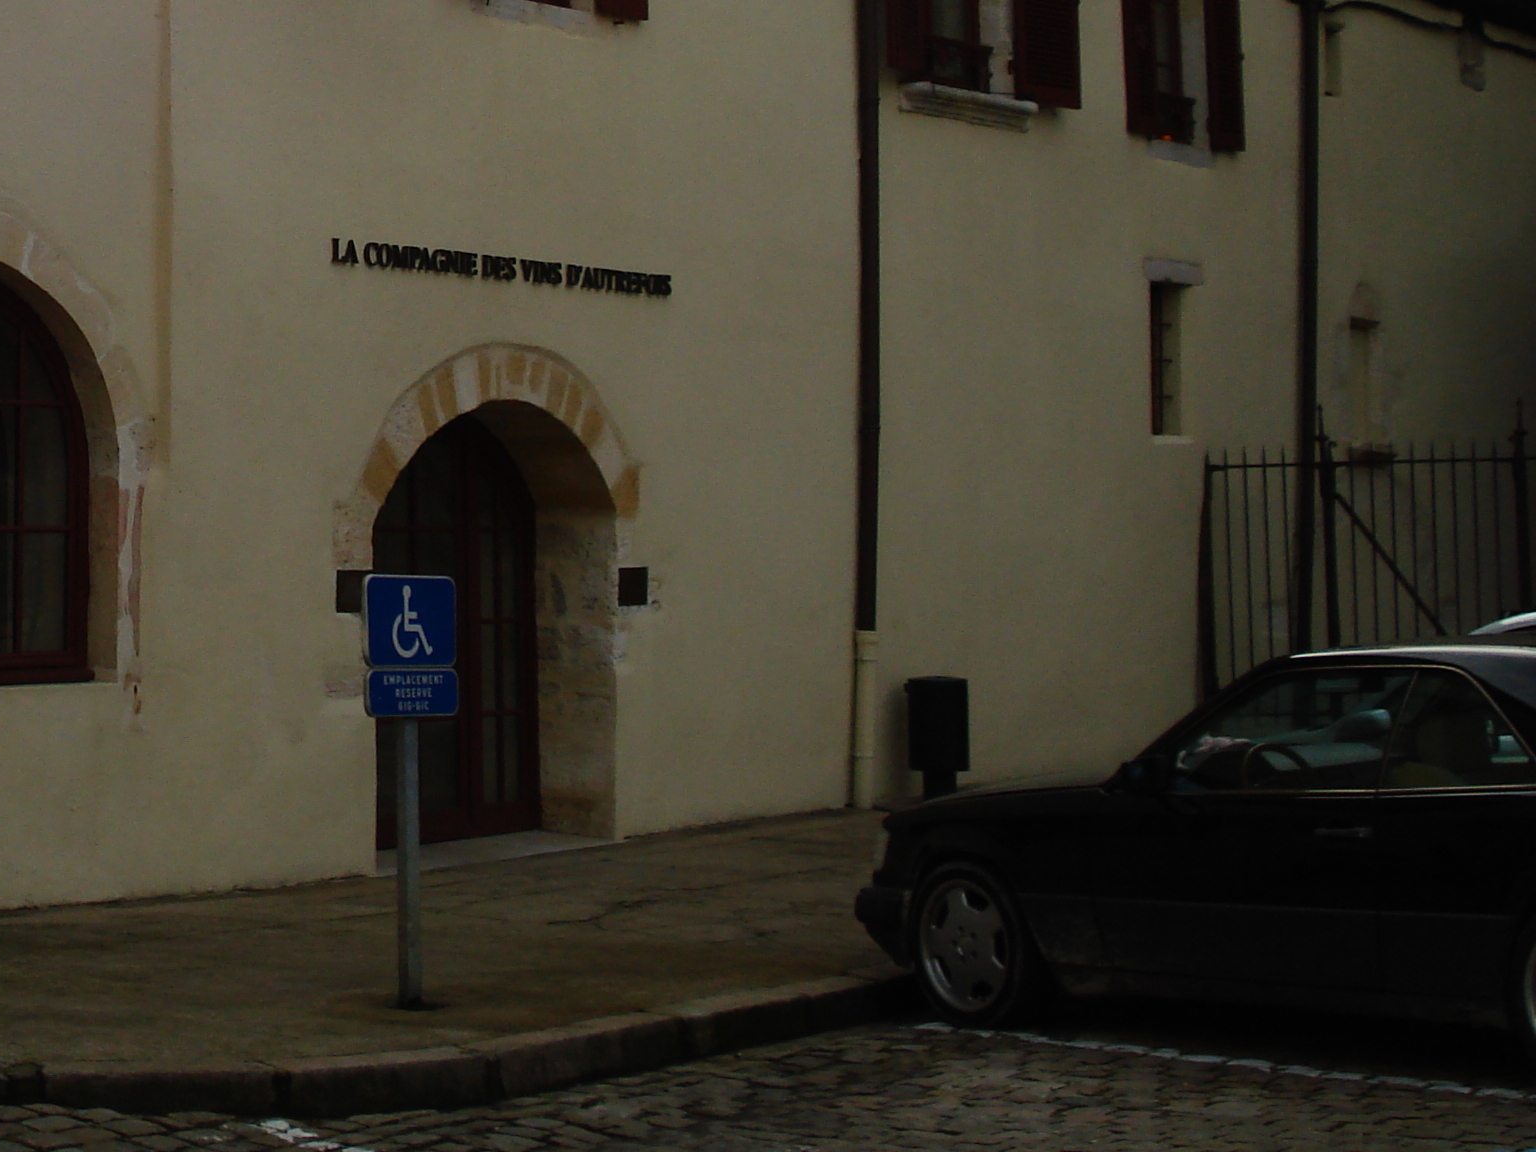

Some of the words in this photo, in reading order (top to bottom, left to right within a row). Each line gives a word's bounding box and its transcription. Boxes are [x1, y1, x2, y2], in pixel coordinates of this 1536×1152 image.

[331, 238, 359, 264] LA
[364, 242, 478, 276] COMPAGNIE
[482, 254, 517, 281] DES
[520, 259, 562, 285] VINS
[566, 264, 672, 296] D'AUTREFOIS
[383, 674, 444, 685] EMPLACEMENT
[397, 700, 430, 712] GIG-GIC
